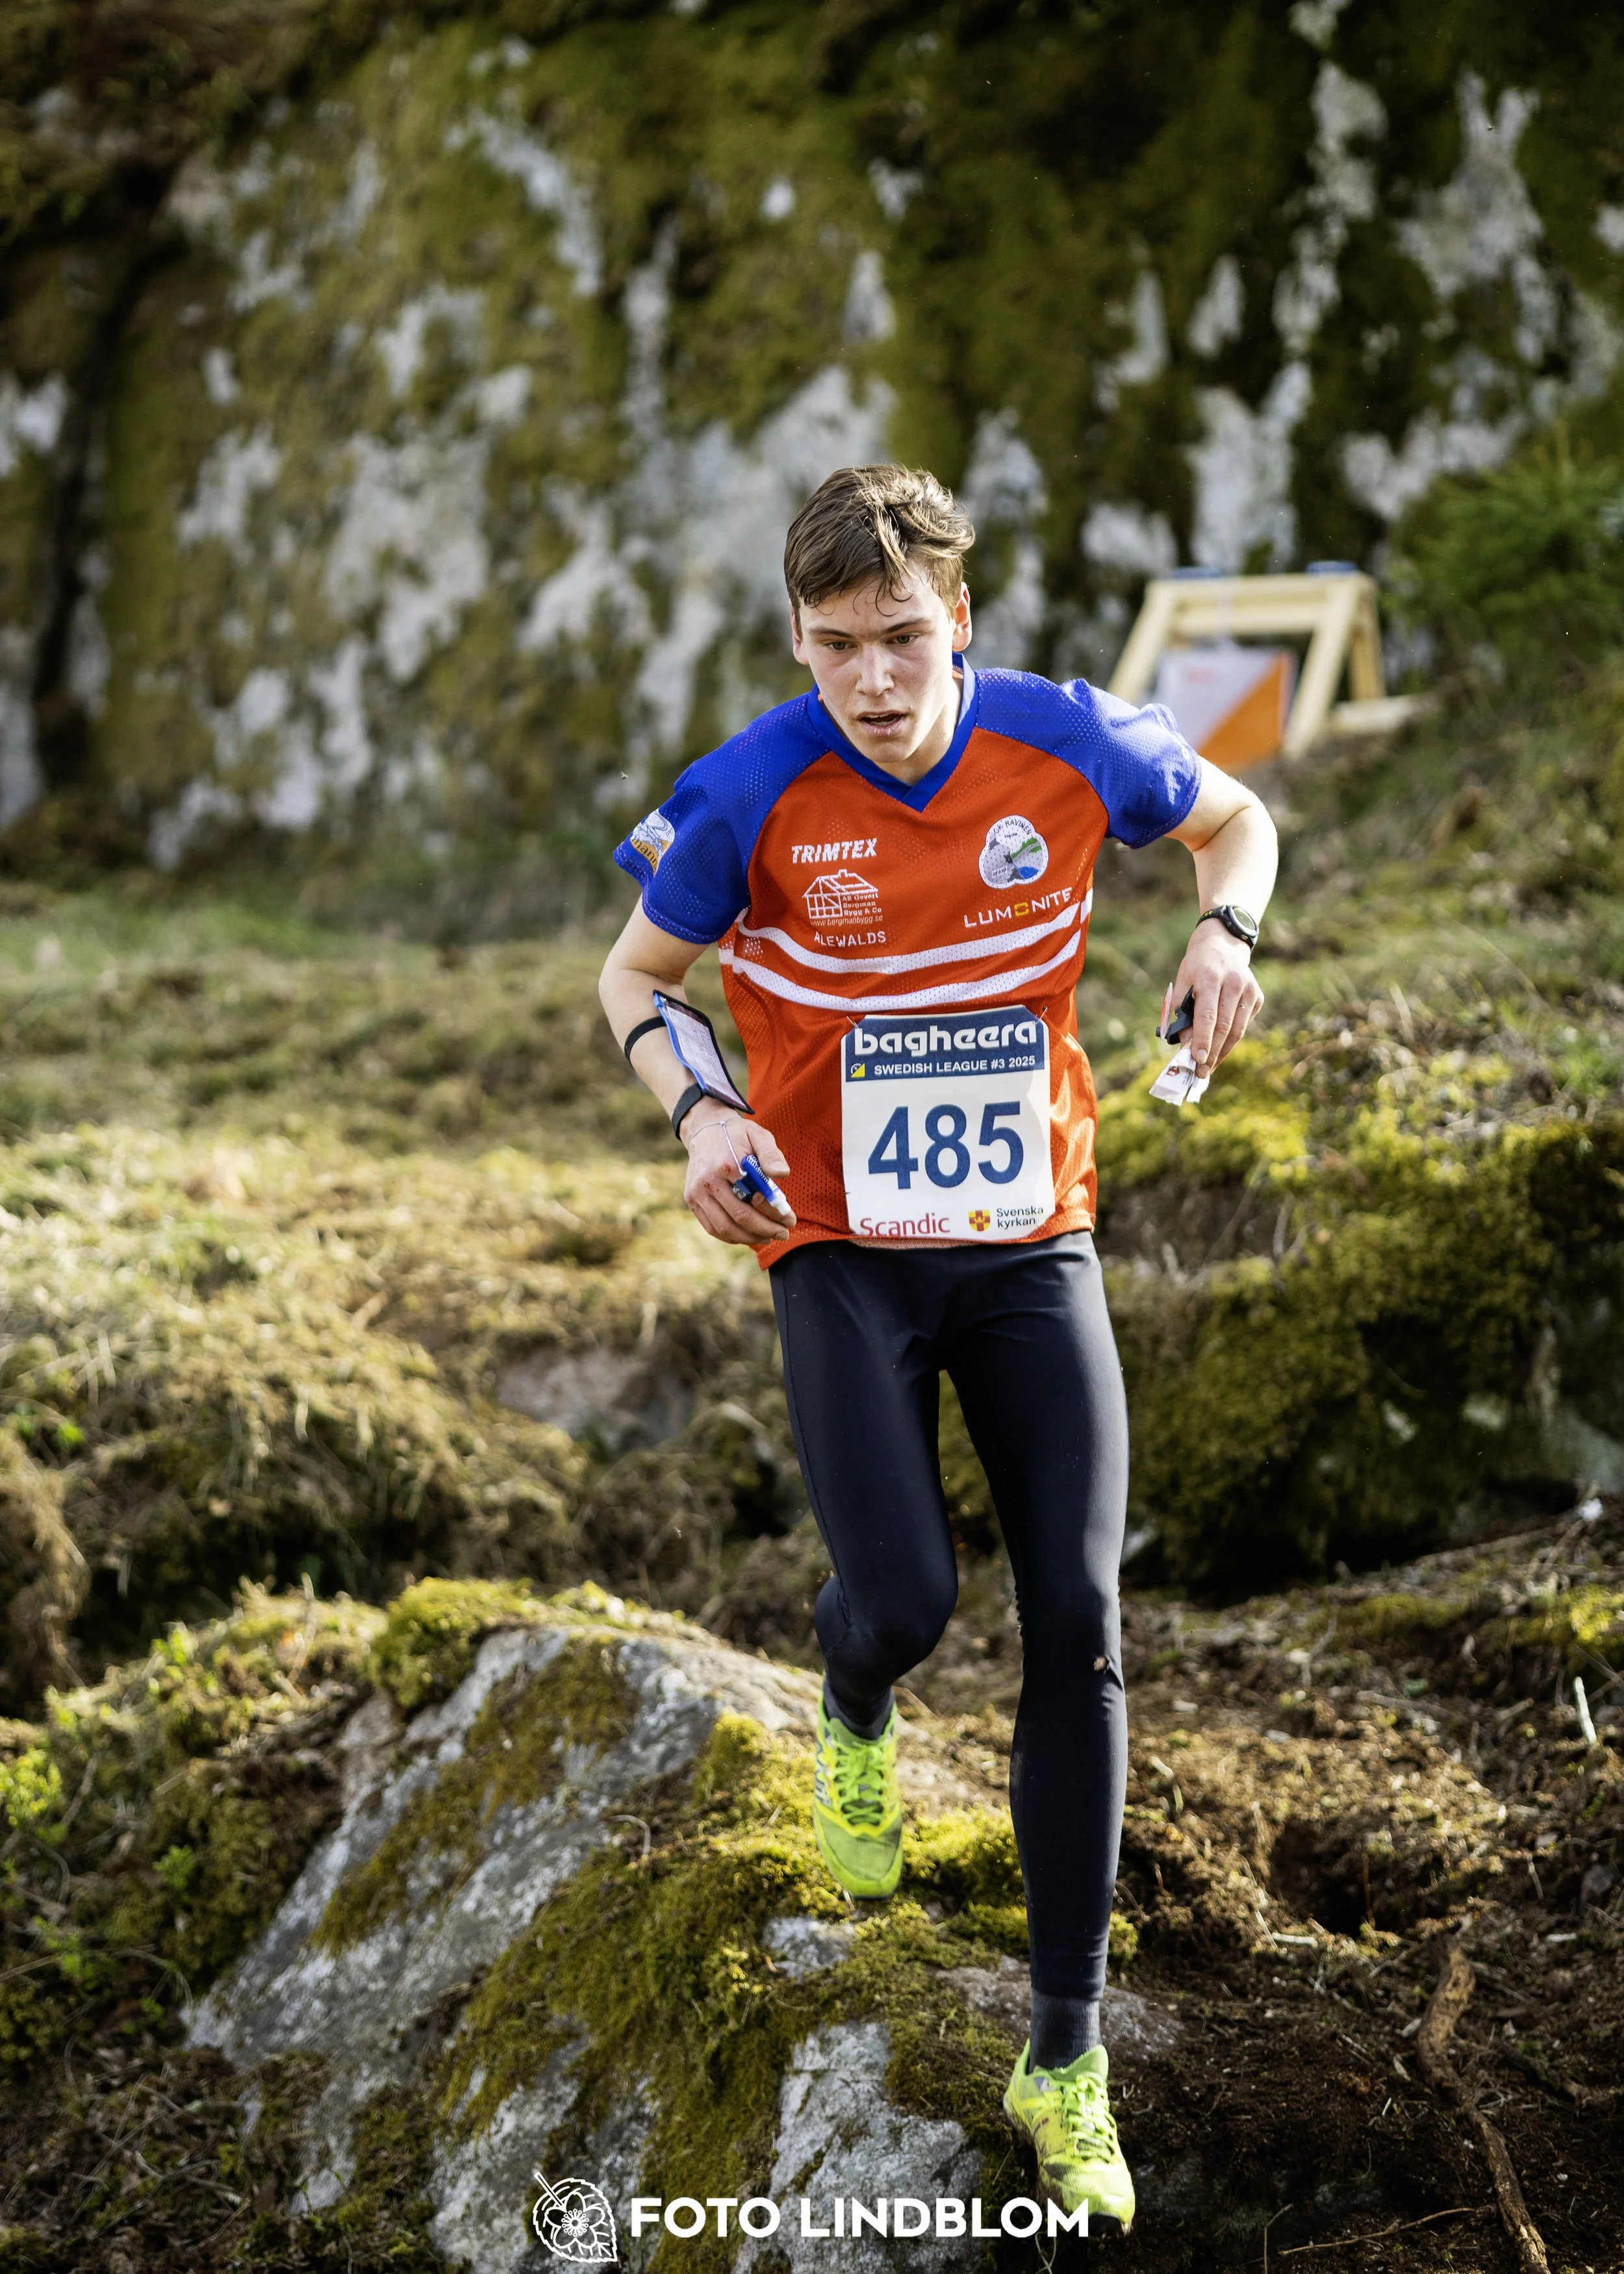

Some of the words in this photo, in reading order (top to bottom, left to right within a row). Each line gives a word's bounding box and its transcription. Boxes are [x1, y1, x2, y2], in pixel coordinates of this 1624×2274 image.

[993, 823, 1004, 834] OK
[1005, 818, 1032, 836] RAVINEN
[791, 837, 877, 863] TRIMTEX
[963, 886, 1072, 928] LUMONITE
[814, 931, 886, 947] ALEWALDS
[855, 1021, 1037, 1057] bagheera
[874, 1062, 932, 1076] SWEDISH
[936, 1060, 987, 1073] LEAGUE
[991, 1057, 1005, 1069] #3
[1008, 1054, 1035, 1068] 2025
[868, 1101, 1024, 1190] 485
[996, 1205, 1044, 1218] Svenska
[859, 1212, 950, 1236] Scandic
[997, 1218, 1036, 1230] kyrkan
